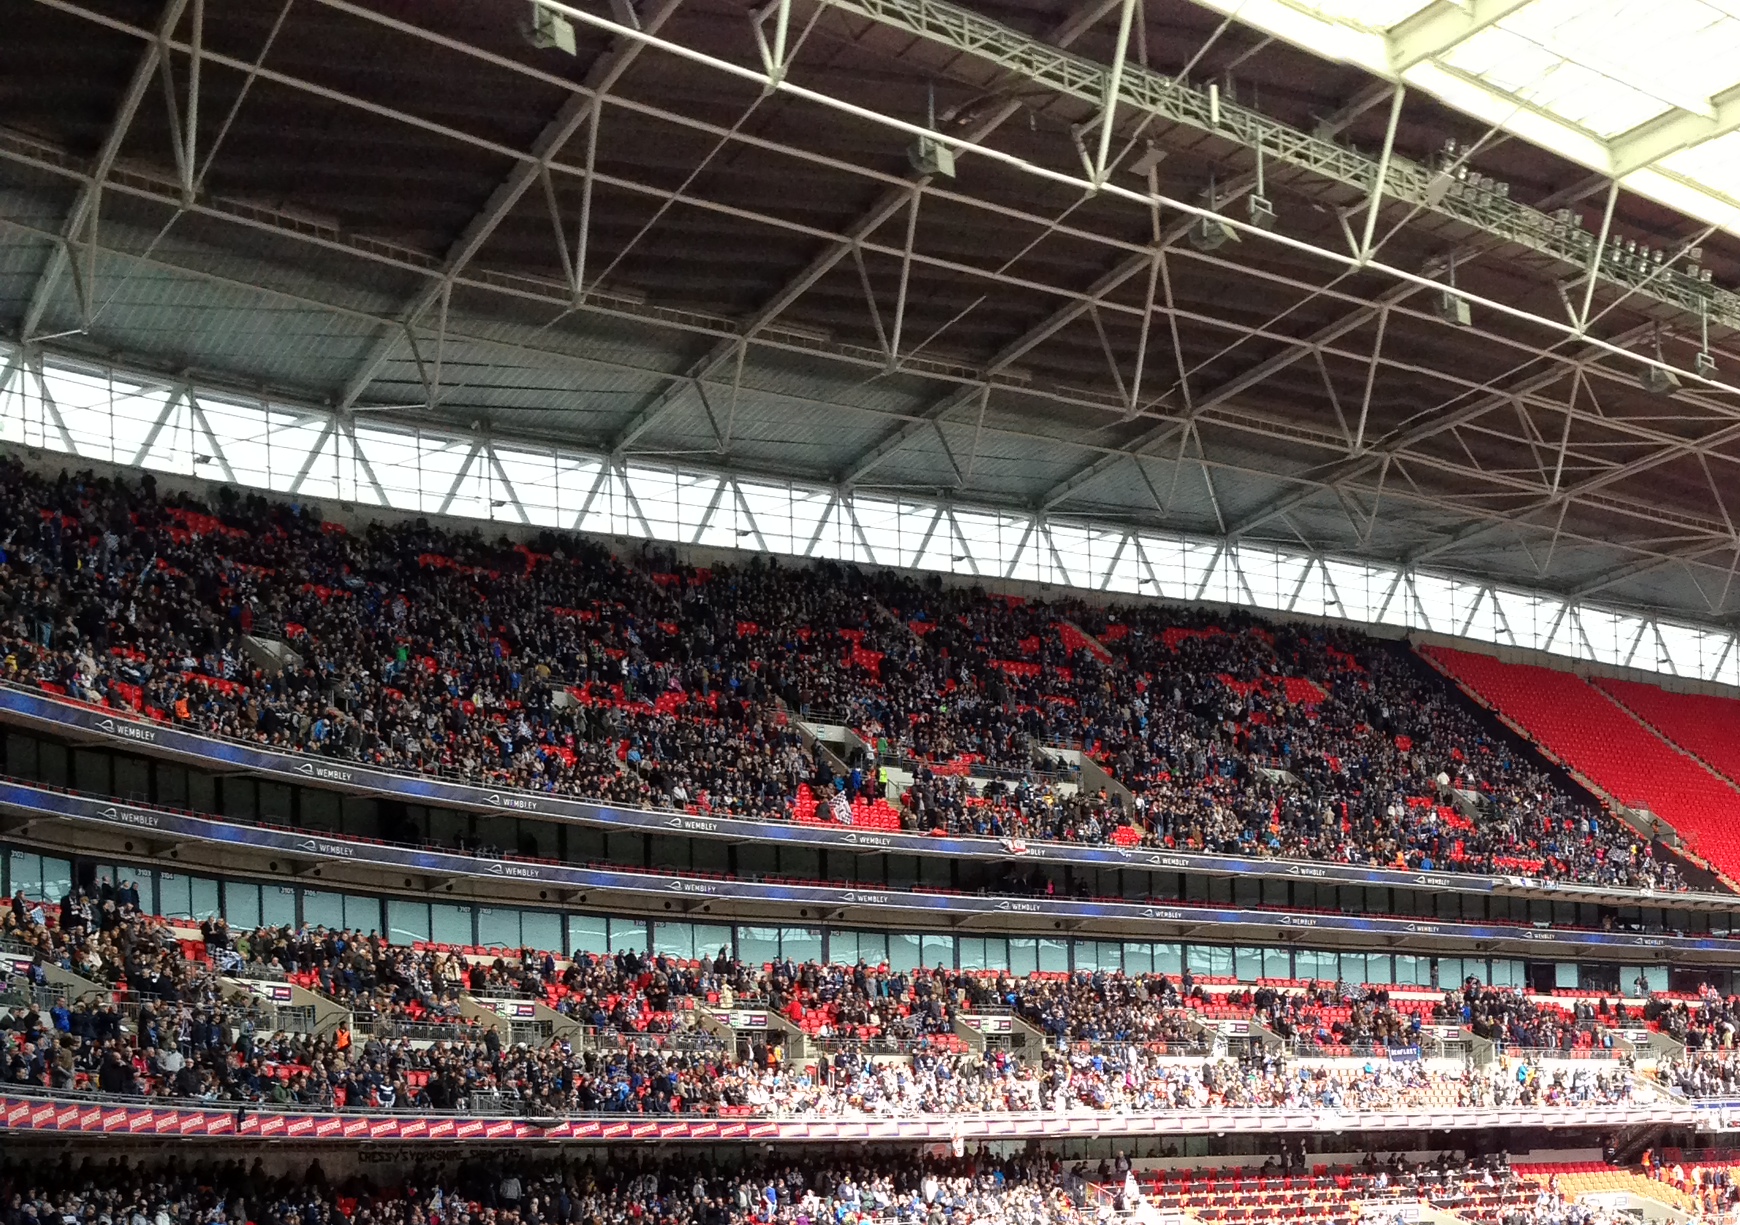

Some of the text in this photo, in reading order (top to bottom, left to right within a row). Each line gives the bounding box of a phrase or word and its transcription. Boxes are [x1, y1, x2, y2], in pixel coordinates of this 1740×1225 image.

[117, 725, 155, 741] WEMBLEY
[316, 768, 352, 781] WEMBLEY
[503, 798, 537, 810] WEMBLEY
[121, 812, 158, 826] WEMBLEY
[684, 820, 717, 830] WEMBLEY
[859, 836, 891, 846] WEMBLEY
[319, 844, 353, 855] WEMBLEY
[505, 867, 539, 877] WEMBLEY
[684, 884, 716, 893] WEMBLEY
[858, 894, 888, 902] WEMBLEY
[1011, 902, 1040, 911] WEMBLEY
